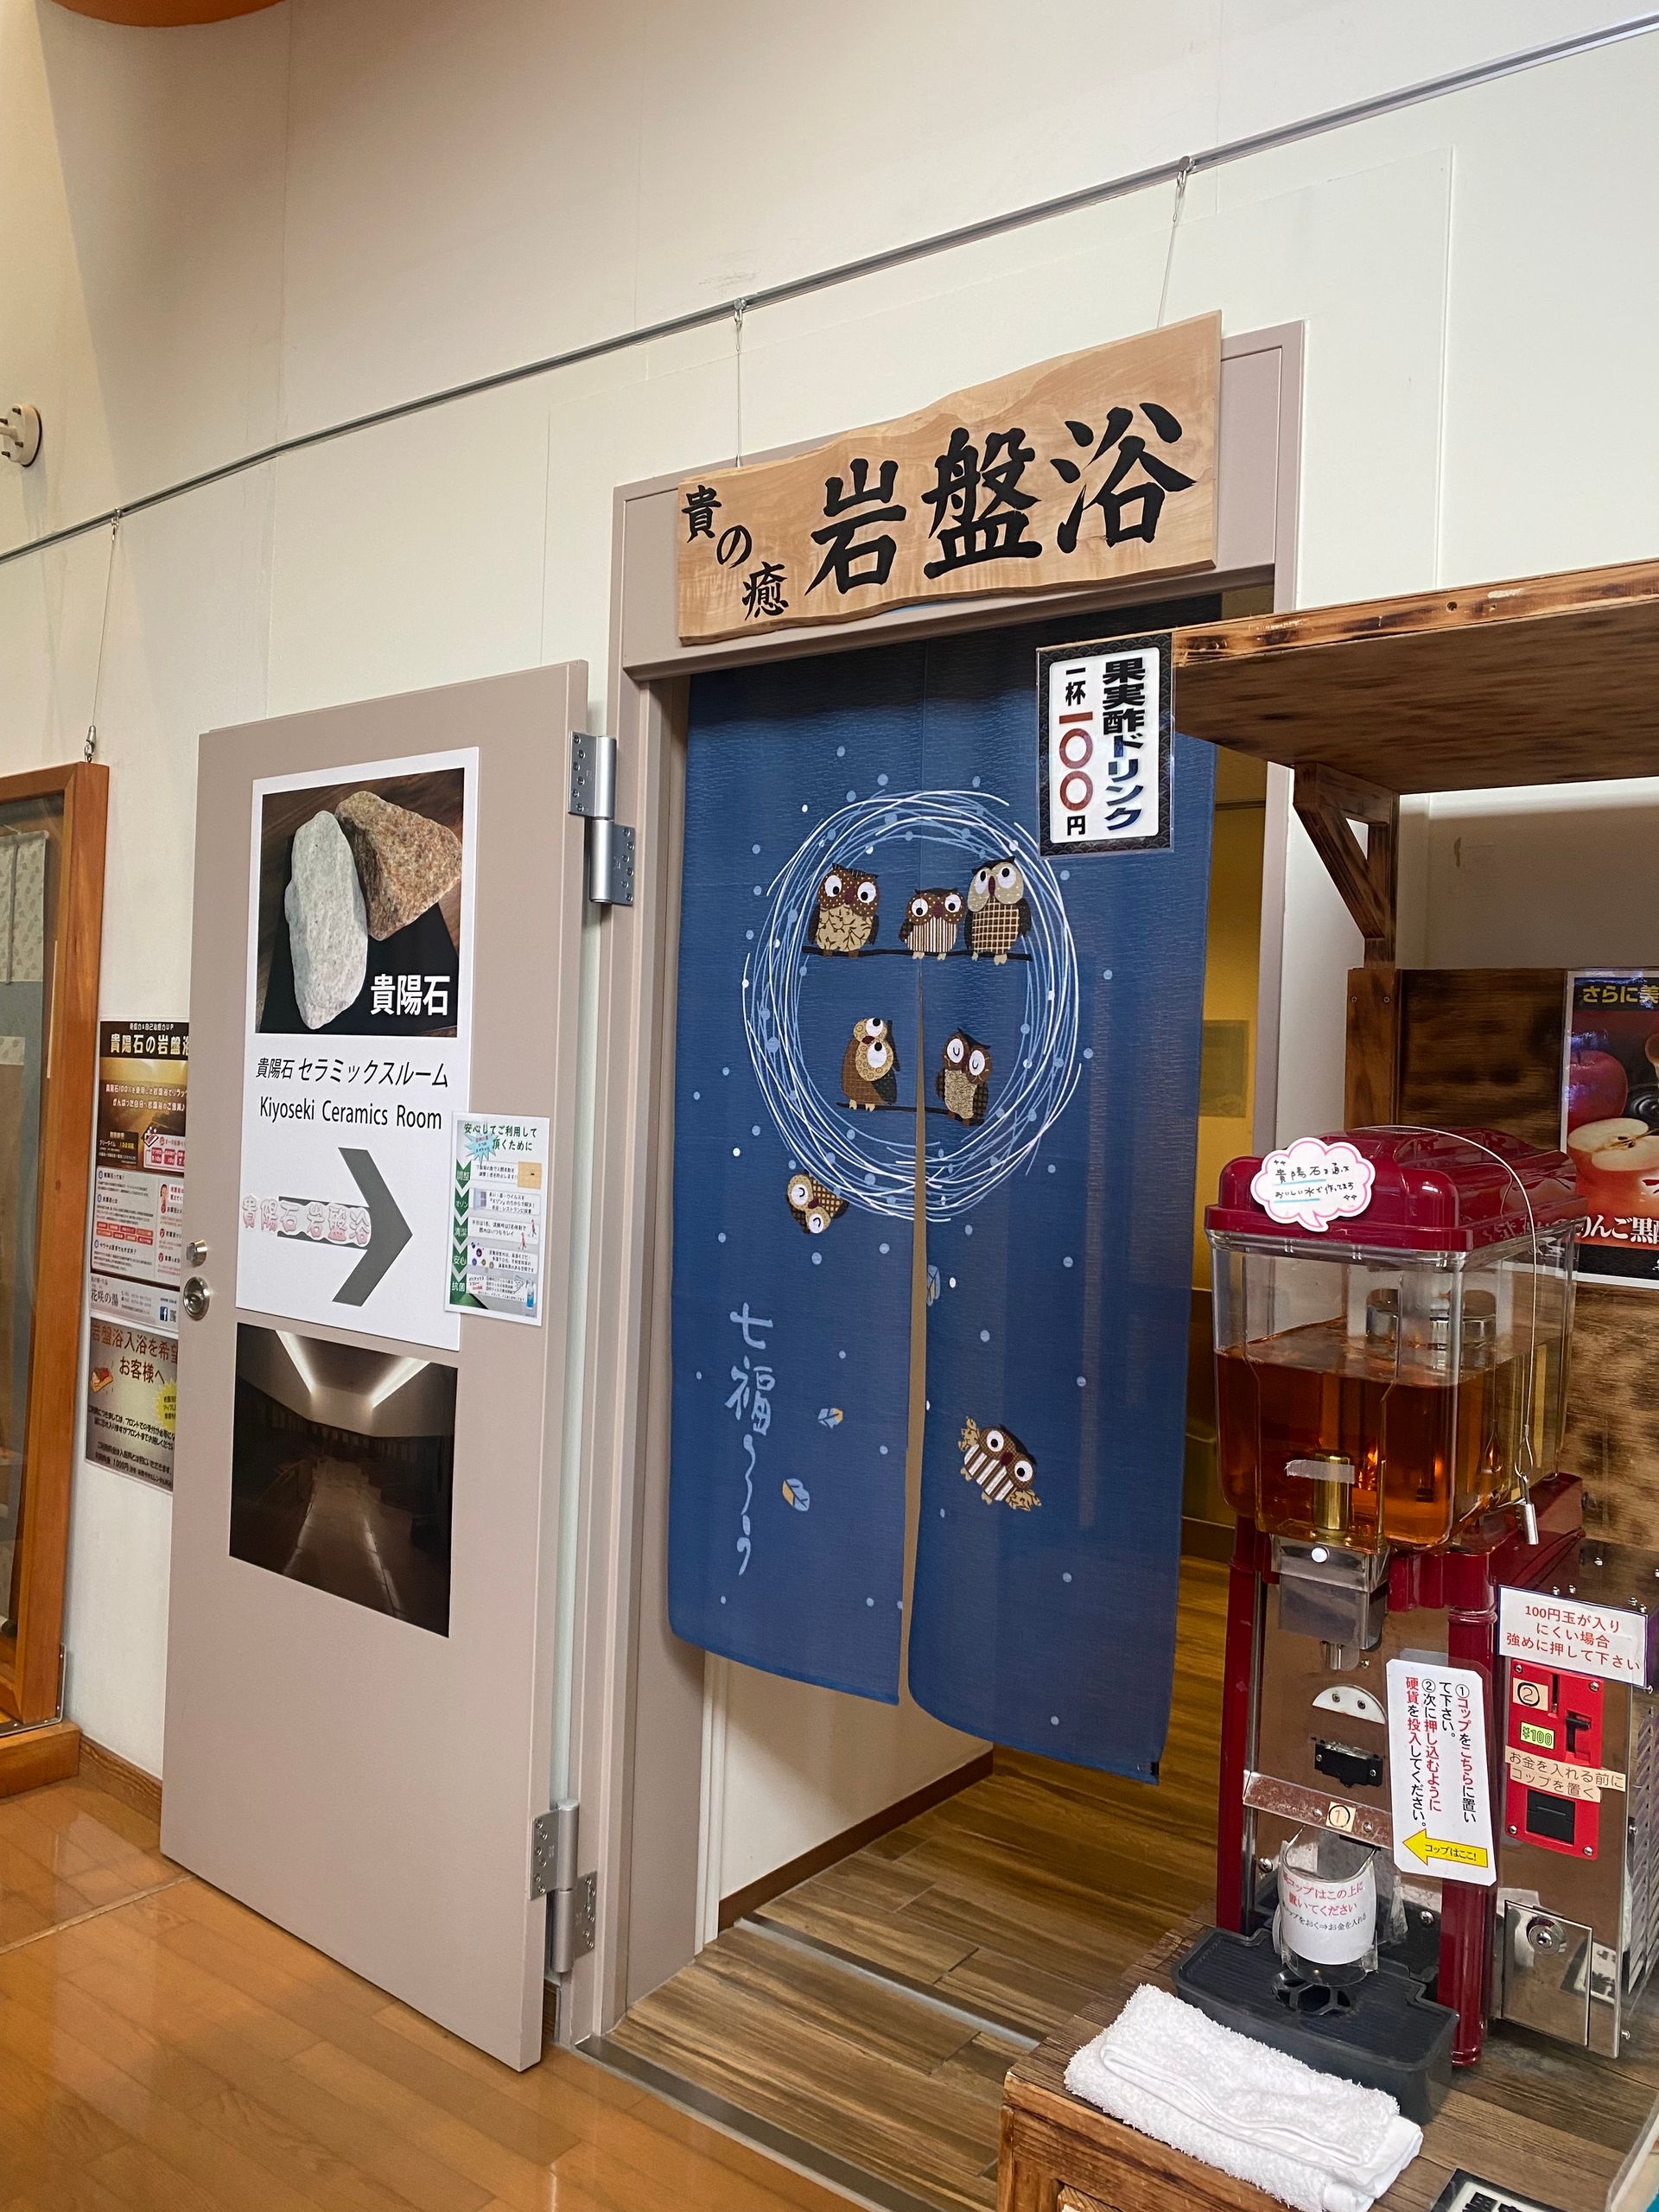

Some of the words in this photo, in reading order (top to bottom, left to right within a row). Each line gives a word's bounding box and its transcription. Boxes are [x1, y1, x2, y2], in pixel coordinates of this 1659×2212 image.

[804, 403, 1196, 596] 岩盤浴
[682, 485, 789, 620] 貴の癒
[1103, 657, 1145, 830] 果実酢ドリンク
[370, 973, 450, 1017] 貴陽石
[256, 1057, 295, 1079] 貴陽石
[298, 1058, 448, 1088] セラミックスルーム
[260, 1096, 315, 1123] Kiyoseki
[322, 1100, 388, 1125] Ceramics
[397, 1104, 442, 1129] Room
[493, 1139, 532, 1151] 頂くために
[454, 1255, 466, 1265] 安心
[119, 1356, 165, 1385] お客様へ
[1524, 1605, 1620, 1633] 100円玉が入り
[1537, 1622, 1610, 1649] にくい場合
[1507, 1632, 1640, 1671] 強めに押して下さい
[1440, 1681, 1455, 1738] て下さい。
[1405, 1676, 1427, 1827] 硬貨を投入してください。
[1422, 1679, 1442, 1812] ②次に押し込むように
[1522, 1726, 1553, 1746] ¥100
[1455, 1684, 1476, 1823] ①コップをこちらに置い
[1510, 1751, 1624, 1790] お金を入れる前に
[1511, 1767, 1595, 1800] コップを置く
[1425, 1843, 1477, 1861] コップはここ!
[1289, 1892, 1357, 1916] 置いてください
